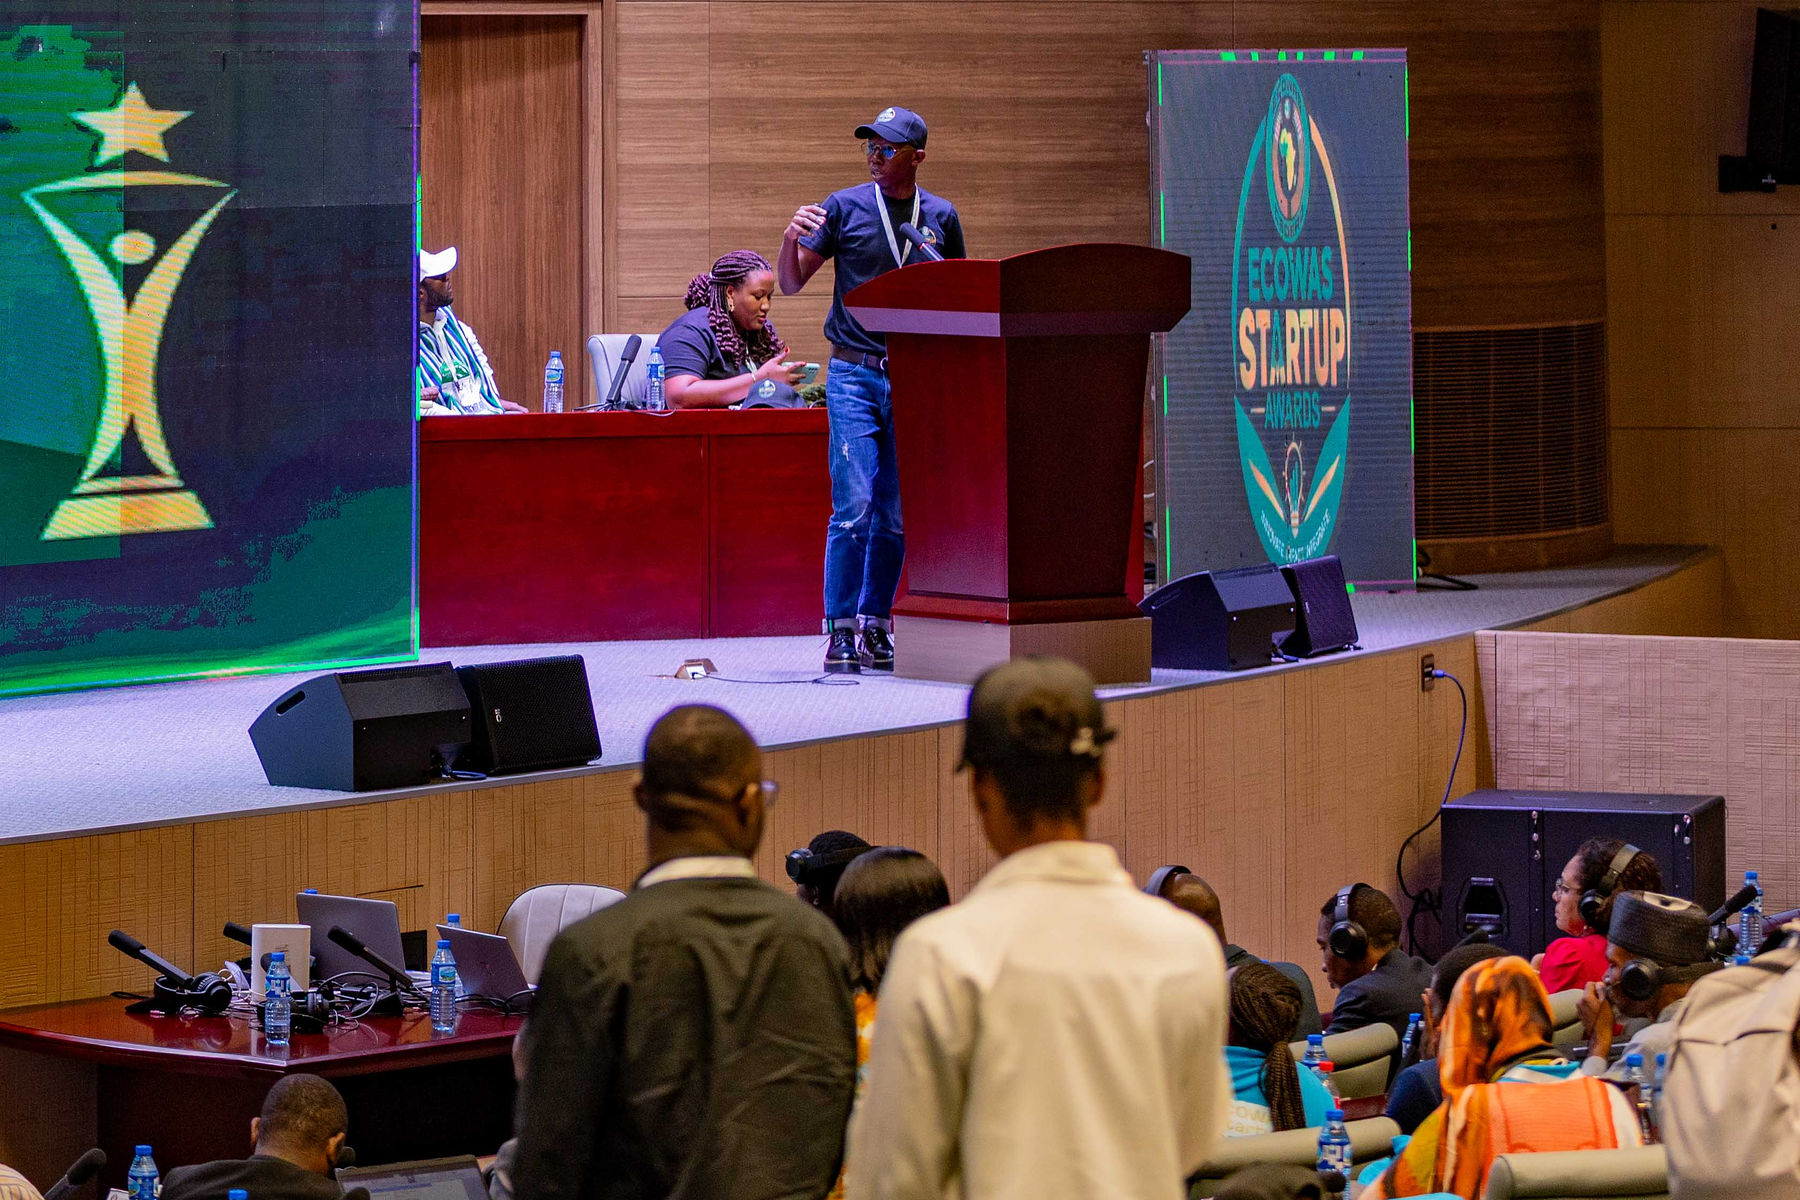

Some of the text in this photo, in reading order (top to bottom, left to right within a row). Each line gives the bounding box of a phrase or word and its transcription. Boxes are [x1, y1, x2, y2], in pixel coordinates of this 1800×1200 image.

[1248, 246, 1334, 302] ECOWAS
[1239, 307, 1345, 390] STARTUP
[1264, 391, 1321, 429] AWARDS
